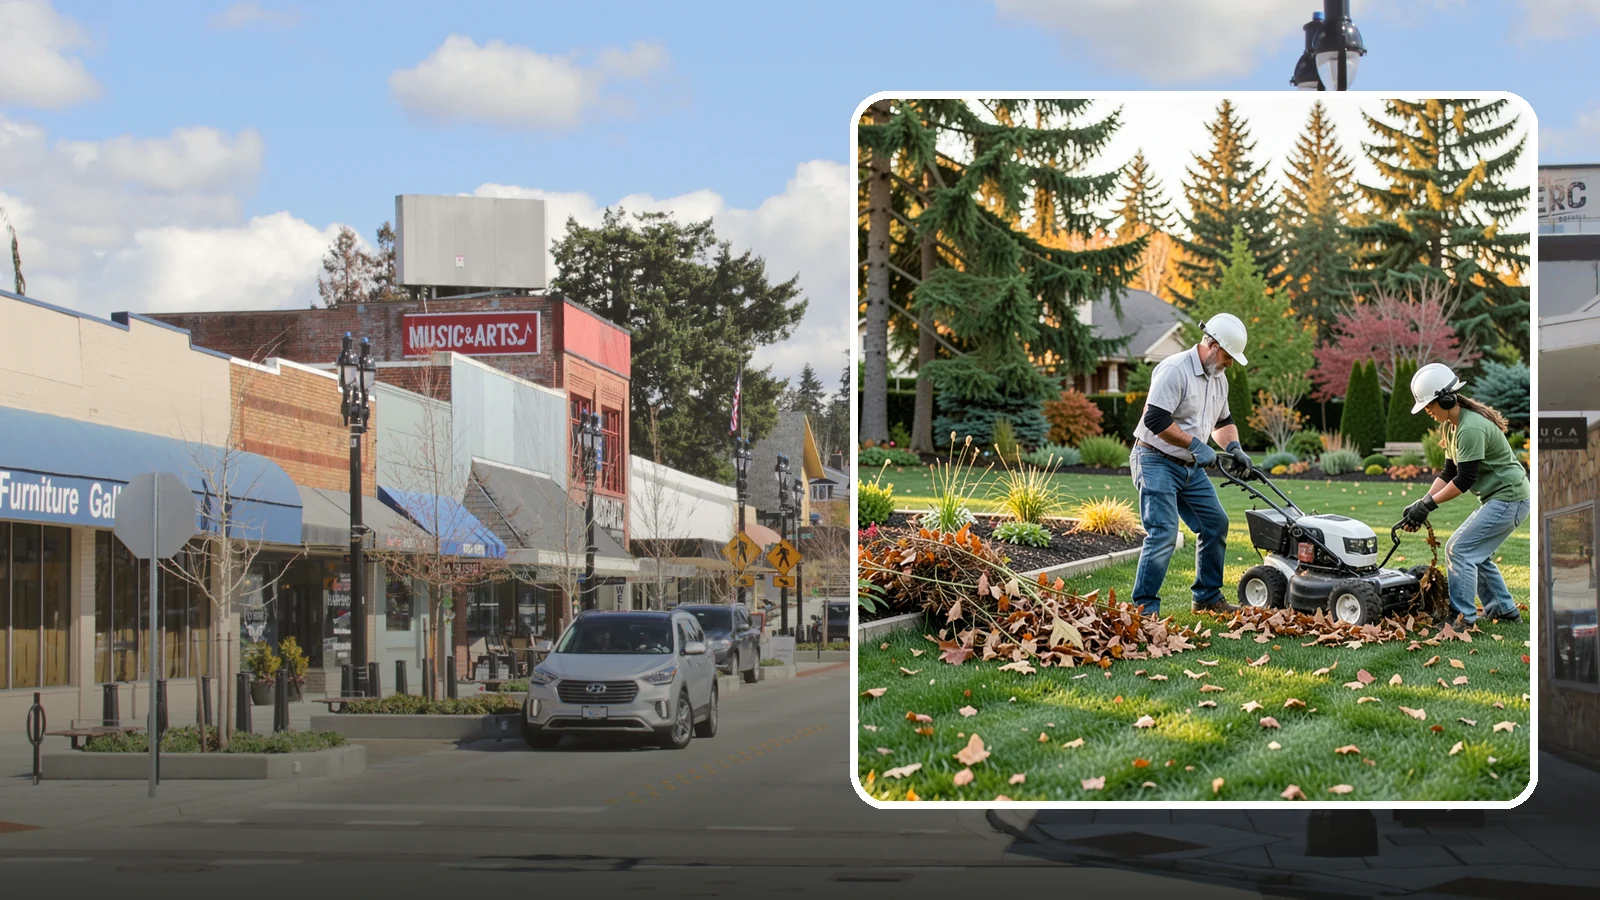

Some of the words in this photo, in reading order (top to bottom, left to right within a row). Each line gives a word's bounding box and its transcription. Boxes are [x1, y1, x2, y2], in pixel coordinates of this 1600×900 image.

[0, 471, 79, 515] Furniture
[89, 482, 122, 519] Gal
[453, 564, 479, 574] SUSHI
